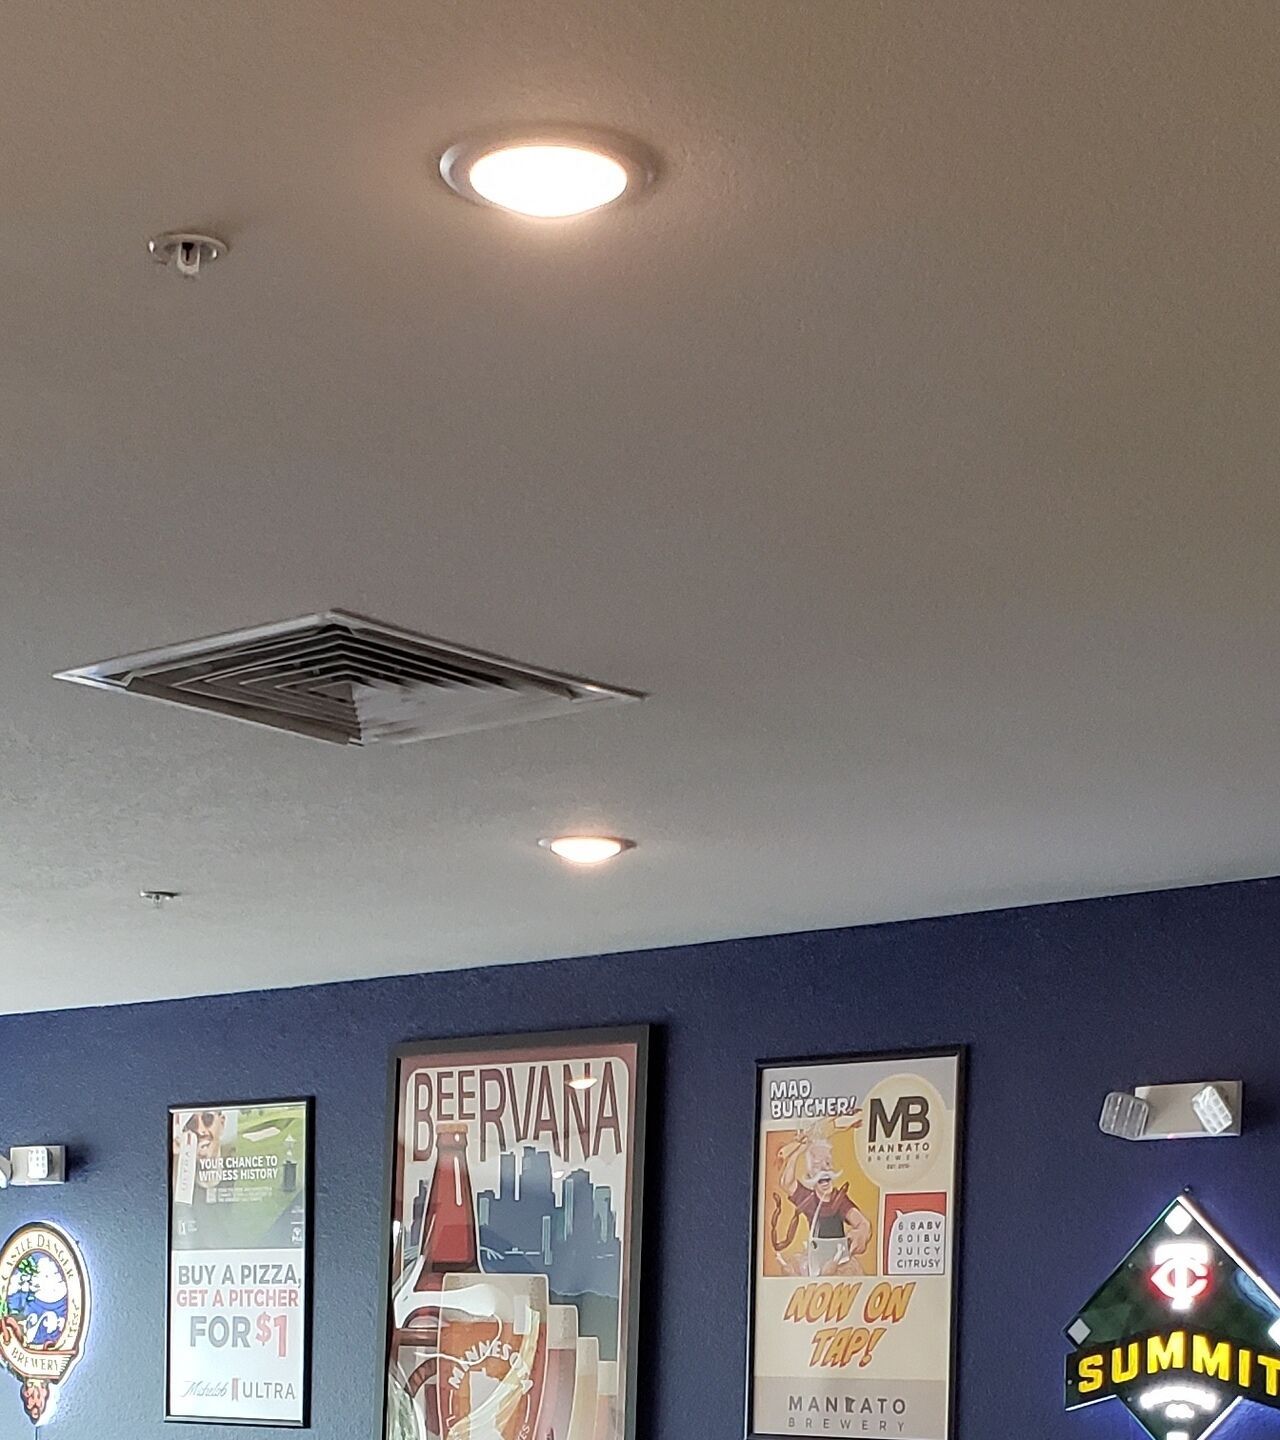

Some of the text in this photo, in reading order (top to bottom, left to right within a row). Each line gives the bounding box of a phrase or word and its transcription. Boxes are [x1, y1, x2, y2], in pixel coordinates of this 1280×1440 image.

[770, 1080, 812, 1099] MAD
[413, 1061, 623, 1162] BEERVANA
[771, 1097, 857, 1119] BUTCHER!
[869, 1096, 931, 1143] MB
[200, 1155, 278, 1170] YOUR CHANCE TO
[199, 1168, 279, 1182] WITNESS HISTORY
[897, 1246, 941, 1256] JUICY
[896, 1258, 941, 1269] CITRUSY
[178, 1264, 301, 1288] BUY A PIZZA,
[177, 1289, 299, 1307] GET A PITCHER
[784, 1281, 917, 1323] NOW ON
[190, 1311, 288, 1358] FOR $1
[809, 1326, 888, 1368] TAP!
[242, 1381, 296, 1400] ULTRA
[788, 1417, 905, 1432] BREWERY
